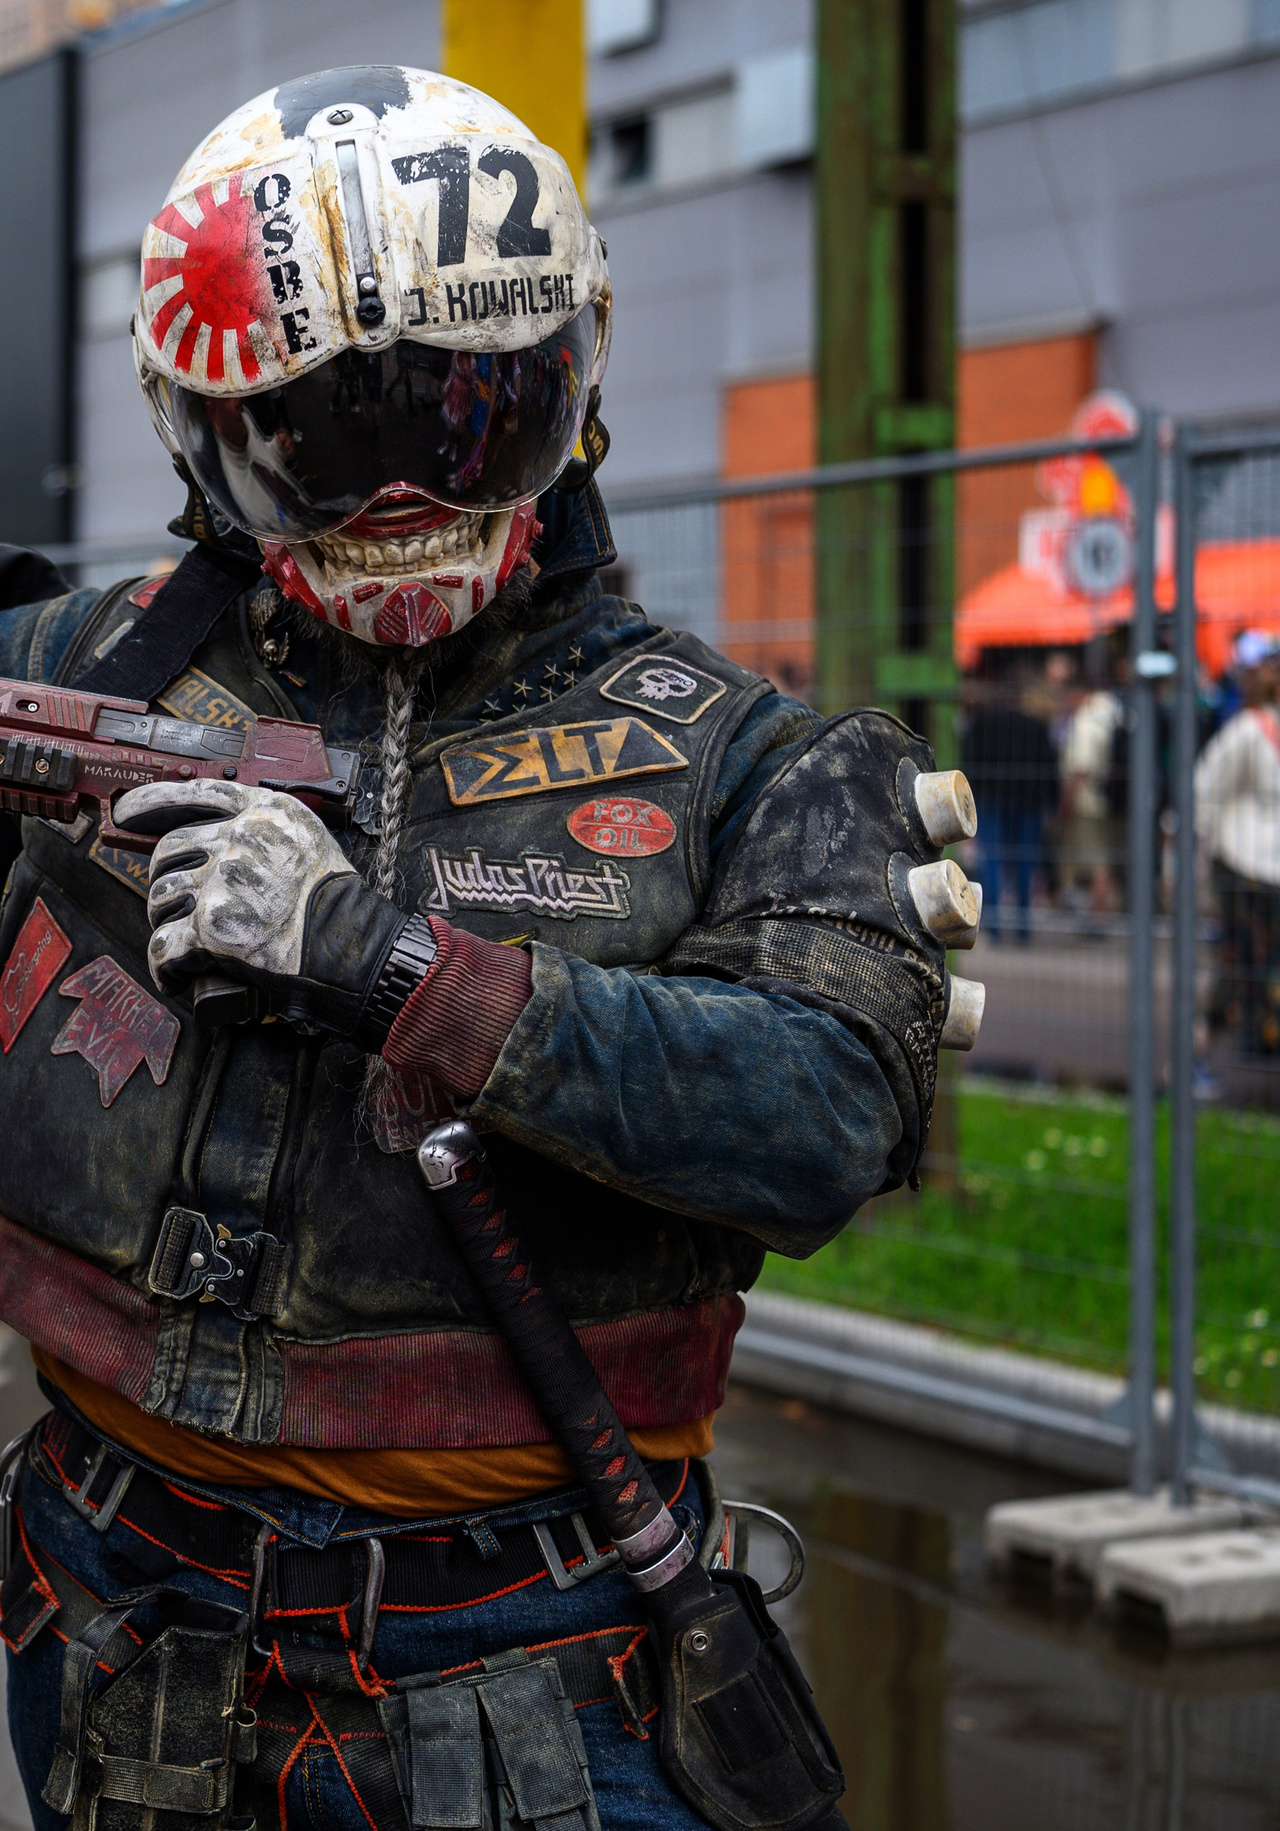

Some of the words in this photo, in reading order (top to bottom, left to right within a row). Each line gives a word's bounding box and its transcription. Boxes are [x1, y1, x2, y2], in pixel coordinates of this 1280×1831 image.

[391, 143, 552, 268] 72
[445, 273, 574, 323] KOWALSKI
[84, 764, 154, 784] MARAUDER
[593, 801, 654, 827] FOX
[594, 827, 647, 851] OIL
[425, 849, 528, 911] Judas
[524, 856, 624, 912] Priest
[54, 1006, 124, 1101] EVIL
